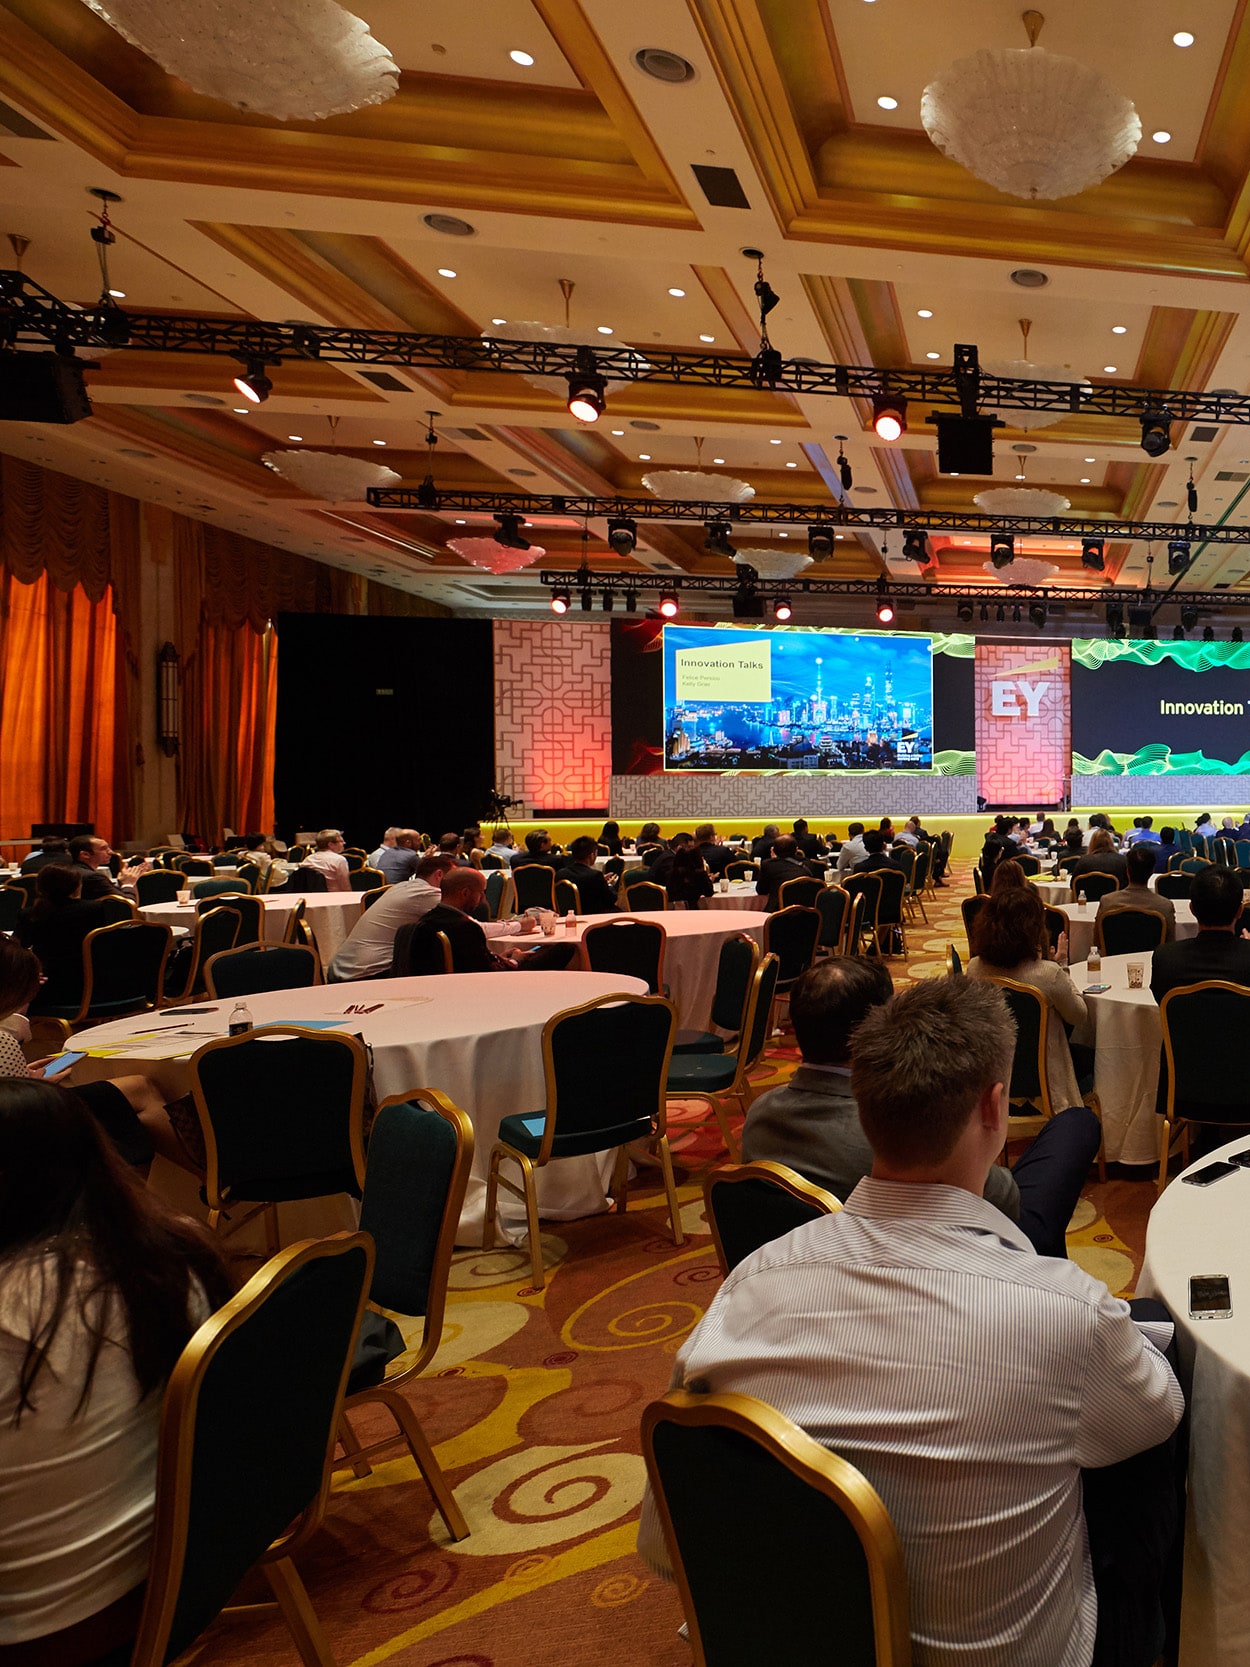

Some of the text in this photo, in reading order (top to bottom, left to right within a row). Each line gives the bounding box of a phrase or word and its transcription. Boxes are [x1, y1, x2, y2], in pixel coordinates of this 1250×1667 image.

[681, 658, 764, 670] Innovation Talks
[991, 680, 1051, 717] EY
[1160, 699, 1244, 716] Innovation
[896, 741, 916, 754] EY
